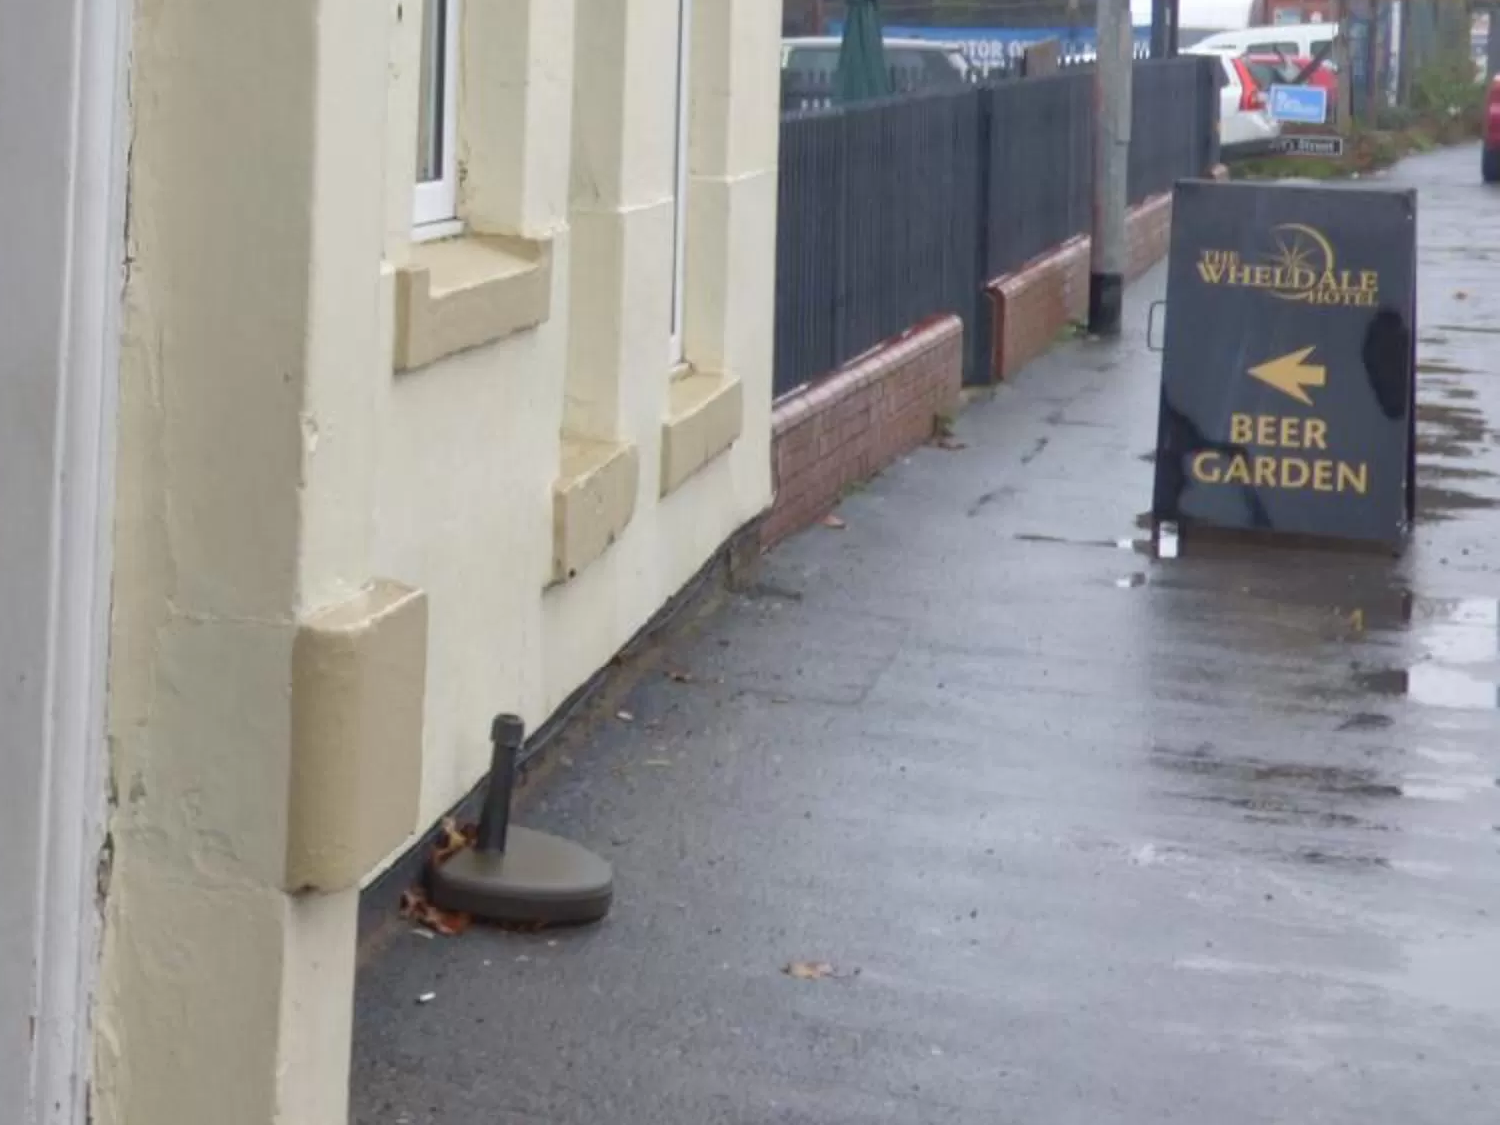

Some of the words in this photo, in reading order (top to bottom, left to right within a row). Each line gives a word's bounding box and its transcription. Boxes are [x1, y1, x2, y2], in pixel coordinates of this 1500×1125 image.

[1196, 260, 1379, 291] WHELDALE
[1307, 289, 1378, 307] HOTEL
[1230, 412, 1328, 450] BEER
[1192, 450, 1369, 495] GARDEN
